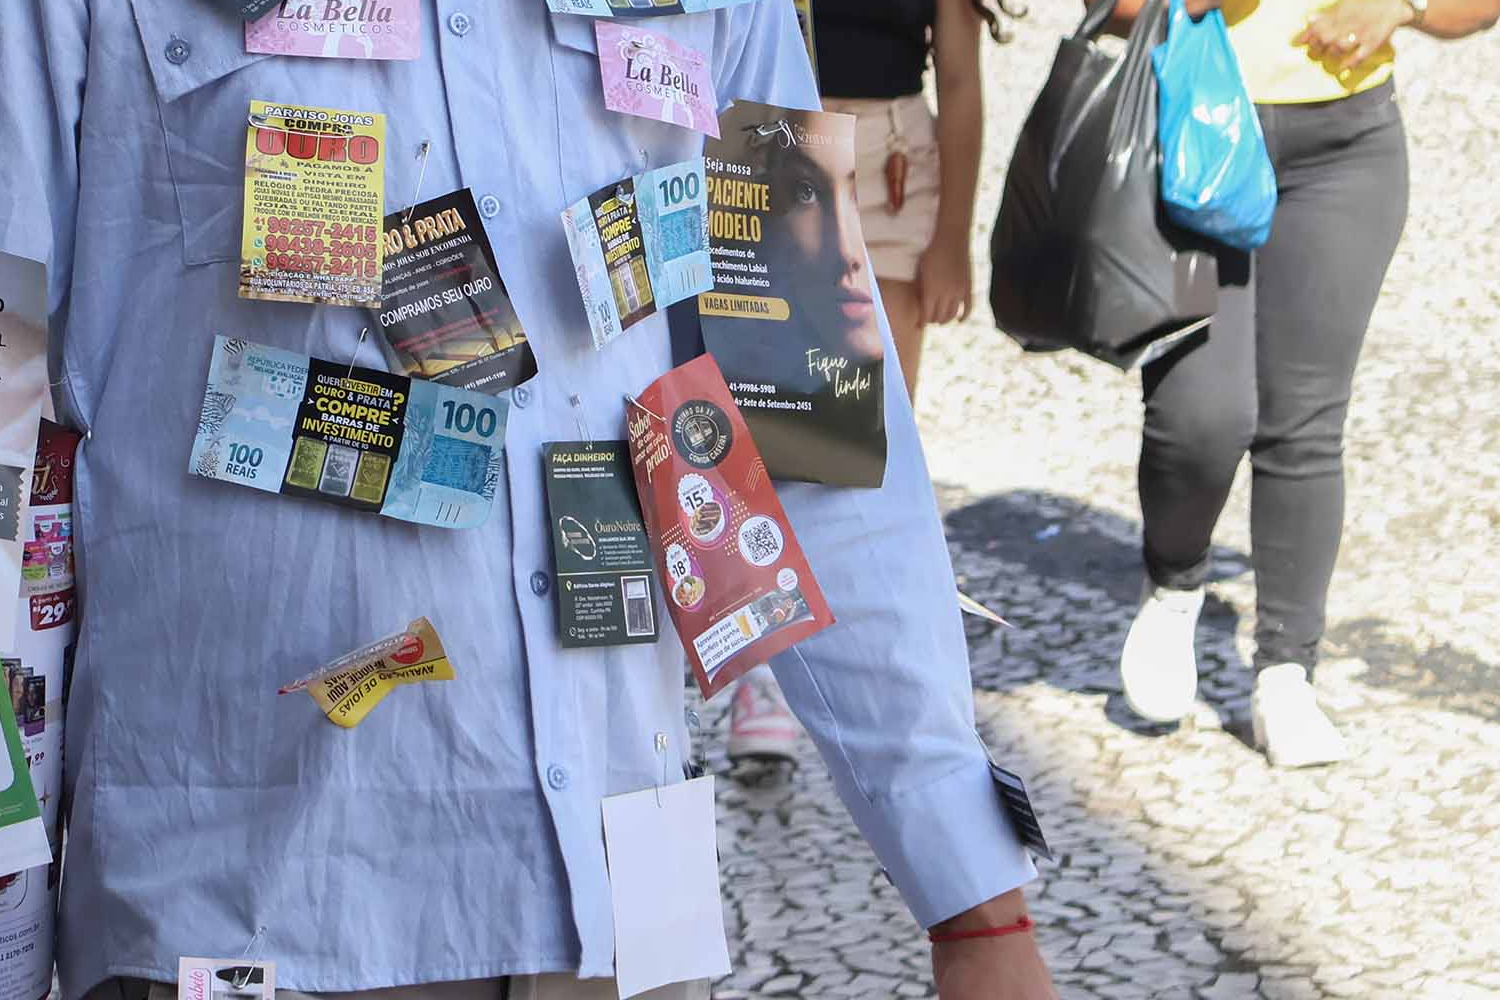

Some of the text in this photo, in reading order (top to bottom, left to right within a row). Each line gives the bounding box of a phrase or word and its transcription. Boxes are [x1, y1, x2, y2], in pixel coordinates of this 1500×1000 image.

[323, 0, 392, 22] Bella
[626, 58, 699, 98] La Bella
[264, 105, 373, 126] PARAISO JOIAS
[254, 123, 379, 167] OURO
[296, 160, 361, 173] PAGAMOS
[303, 169, 341, 179] VISTA
[347, 173, 365, 181] EM
[705, 157, 751, 176] Seja nossa
[302, 178, 366, 189] DINHEIRO
[304, 185, 378, 199] PEDRA PRECIOSA
[658, 166, 700, 212] 100
[707, 177, 770, 212] PACIENTE
[253, 193, 377, 212] QUEBRADAS FALTANDO PARTES
[256, 201, 297, 210] JOIAS
[330, 208, 374, 218] GERAL
[266, 215, 377, 243] 99257-2415
[383, 207, 466, 256] RO & PRATA
[397, 234, 472, 268] JOIAS SOB ENCOMENDA
[709, 248, 755, 259] ocedimentos de
[265, 251, 376, 278] 99257-2415
[711, 261, 768, 273] enchimento Labial
[717, 272, 770, 288] ácido hialurônico
[380, 277, 492, 327] COMPRAMOS SEU OURO
[704, 297, 769, 314] VAGAS LIMITADAS
[806, 348, 848, 382] Fique
[313, 384, 391, 409] OURO & PRATA
[316, 373, 340, 387] QUER
[379, 388, 393, 398] EM
[834, 371, 871, 400] linda!
[314, 395, 391, 426] COMPRE
[734, 398, 812, 411] Av Sete Setembro 2451
[320, 412, 380, 432] BARRAS DE
[438, 397, 498, 440] 100
[629, 412, 651, 443] Sabor
[301, 417, 394, 448] INVESTIMENTO
[225, 440, 264, 469] 100
[553, 453, 614, 468] FAÇA DINHEIRO!
[646, 435, 673, 484] prato!
[224, 462, 257, 479] REAIS
[690, 493, 704, 511] 15
[674, 562, 686, 577] 18
[39, 602, 66, 625] 29
[327, 685, 349, 703] AQUI
[339, 691, 364, 716] JOIAS
